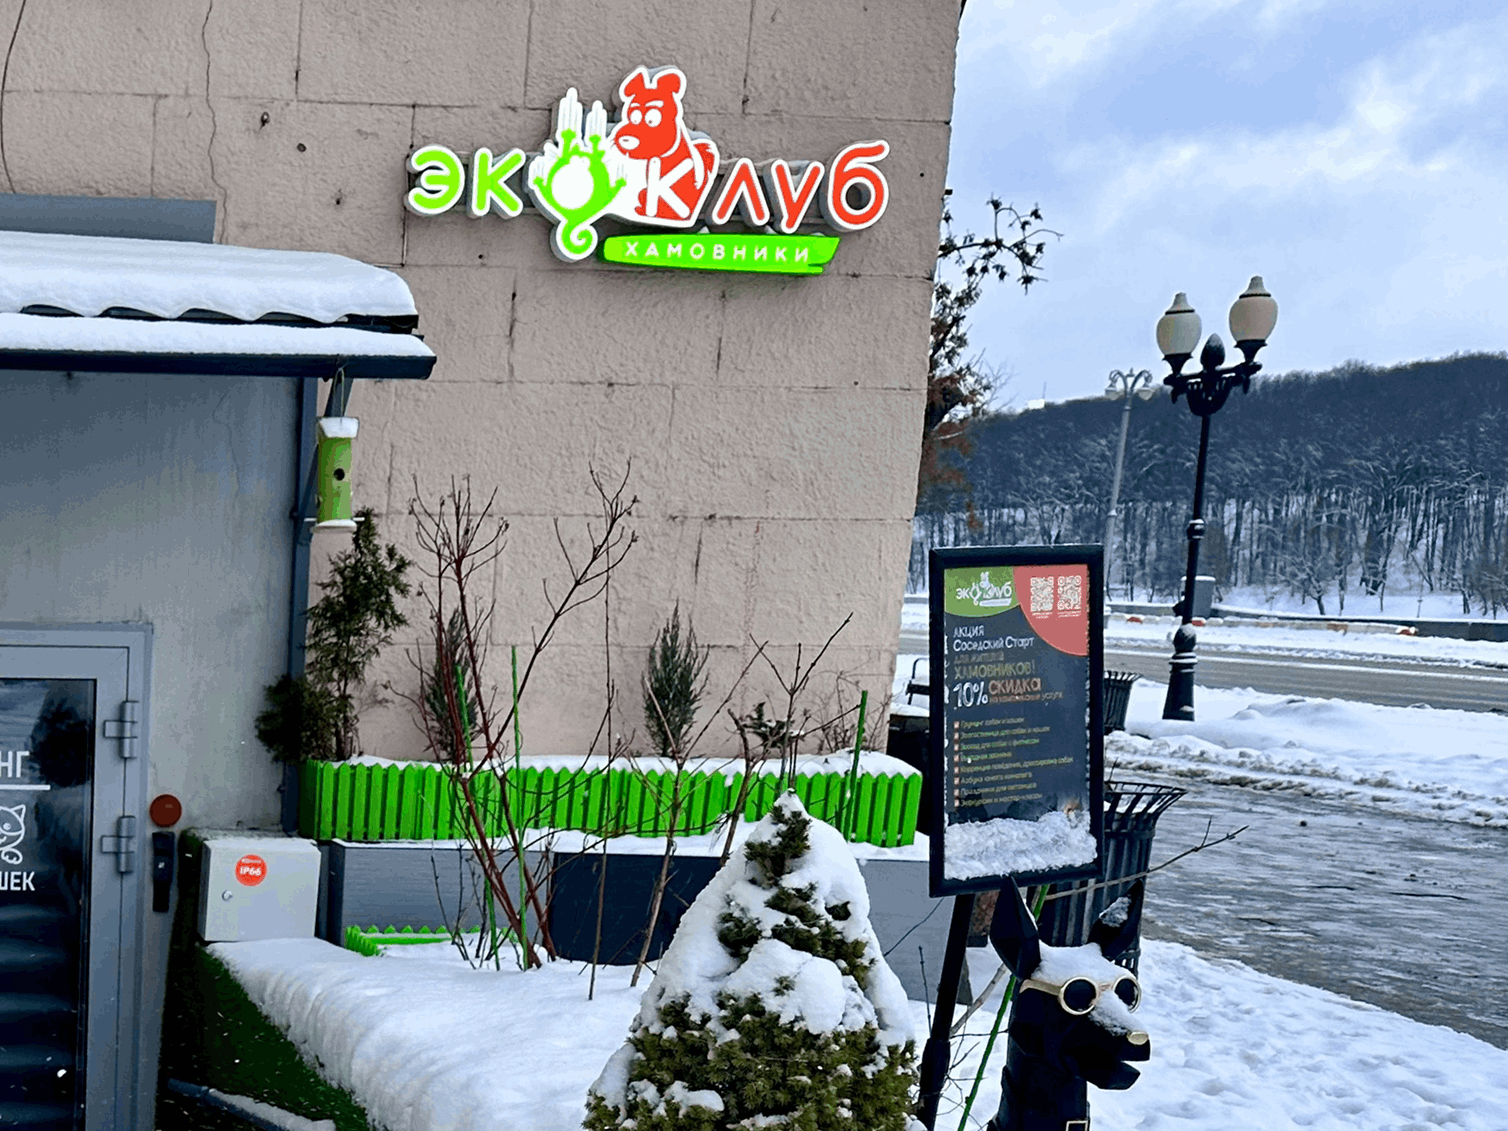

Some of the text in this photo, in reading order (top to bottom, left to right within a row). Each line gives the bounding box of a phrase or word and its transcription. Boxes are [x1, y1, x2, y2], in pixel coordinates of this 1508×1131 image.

[623, 241, 811, 263] ХАМОВНИКИ
[953, 635, 1035, 653] Соседский Старт
[953, 681, 989, 708] 10%
